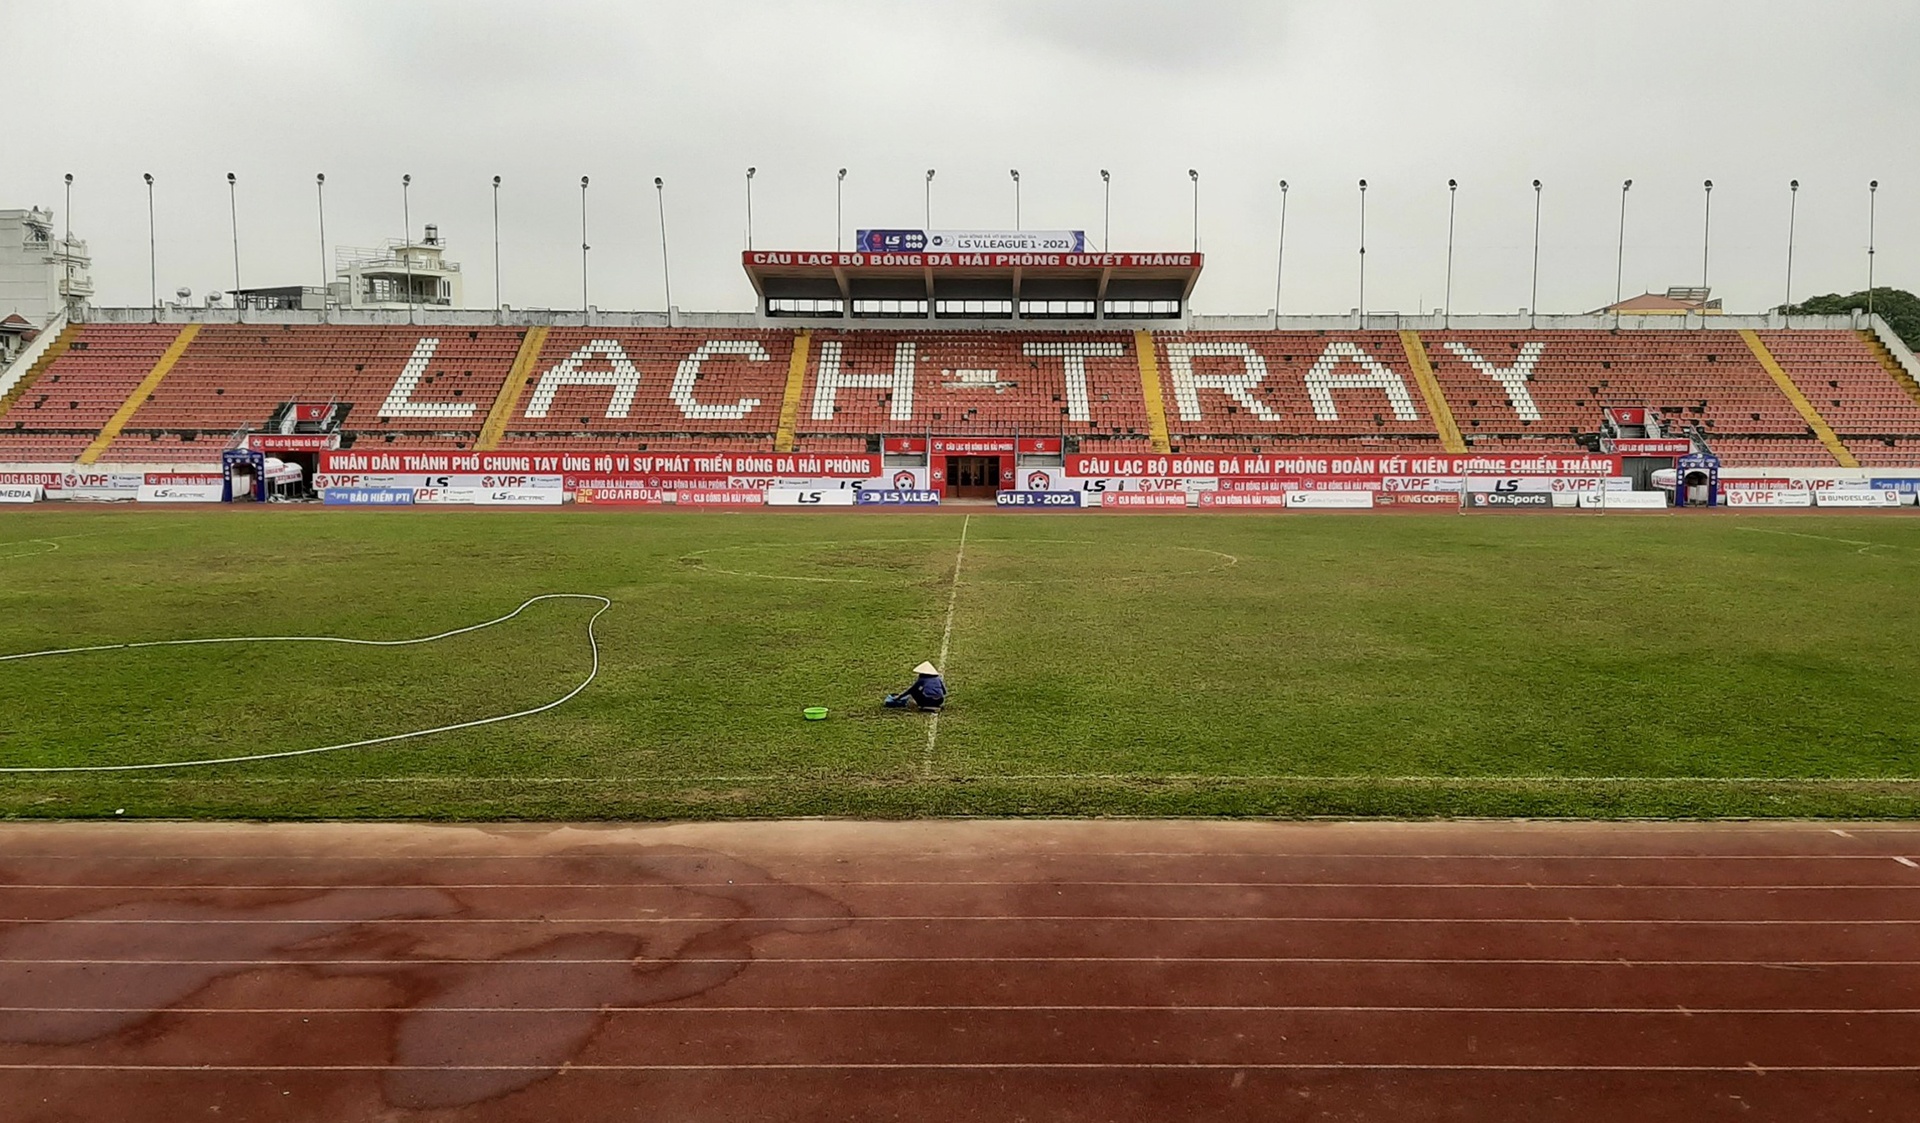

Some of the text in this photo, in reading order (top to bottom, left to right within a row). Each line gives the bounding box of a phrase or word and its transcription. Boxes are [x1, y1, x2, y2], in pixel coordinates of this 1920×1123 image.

[885, 236, 901, 245] LS
[958, 240, 971, 249] LS
[974, 240, 1028, 249] V.LEAGUE
[1030, 240, 1035, 249] 1
[1042, 240, 1069, 249] 2021
[798, 254, 833, 266] LẠC
[839, 253, 864, 266] BỘ
[870, 253, 922, 266] BÓNG
[928, 253, 953, 266] ĐÁ
[958, 253, 990, 266] HẢI
[996, 253, 1060, 266] PHÒNG
[1066, 253, 1127, 267] QUYẾT
[329, 453, 870, 474] NHÂN DÂN THÀNH PHỐ CHUNG TAY ỦNG HỘ VÌ SỰ PHÁT TRIỂN BÓNG ĐÁ HẢI PHÒNG
[1078, 457, 1110, 474] CÂU
[1114, 460, 1143, 477] LẠC
[1147, 457, 1168, 477] BỘ
[1172, 457, 1214, 474] BÓNG
[1219, 457, 1240, 474] ĐÁ
[1244, 455, 1270, 474] HẢI
[1275, 457, 1327, 474] PHÒNG
[1332, 456, 1375, 474] ĐOÀN
[1379, 455, 1408, 474] KẾT
[1412, 457, 1448, 474] KIÊN
[1511, 455, 1557, 474] CHIẾN
[1561, 456, 1613, 474] THẮNG
[0, 474, 62, 484] JOGARBOLA
[79, 475, 109, 487] VPF
[330, 476, 360, 487] VPF
[425, 477, 449, 487] LS
[498, 476, 527, 487] VPF
[745, 479, 775, 489] VPF
[1154, 478, 1183, 490] VPF
[1401, 478, 1430, 490] VPF
[1567, 479, 1597, 490] VPF
[1083, 480, 1106, 492] LS
[1495, 479, 1519, 492] LS
[1805, 479, 1835, 491] VPF
[0, 490, 32, 498] MEDIA
[154, 490, 169, 498] LS
[350, 490, 369, 502] BẢO
[397, 492, 410, 502] PTI
[492, 492, 508, 500] LS
[595, 489, 662, 500] JOGARBOLA
[797, 492, 822, 503] LS
[884, 493, 939, 502] LS V.LEA
[997, 494, 1026, 504] GUE
[1027, 495, 1034, 504] 1
[1043, 495, 1076, 504] 2021
[1291, 494, 1307, 503] LS
[1397, 495, 1458, 503] KING COFFEE
[1586, 495, 1601, 503] LS
[1745, 492, 1774, 503] VPF
